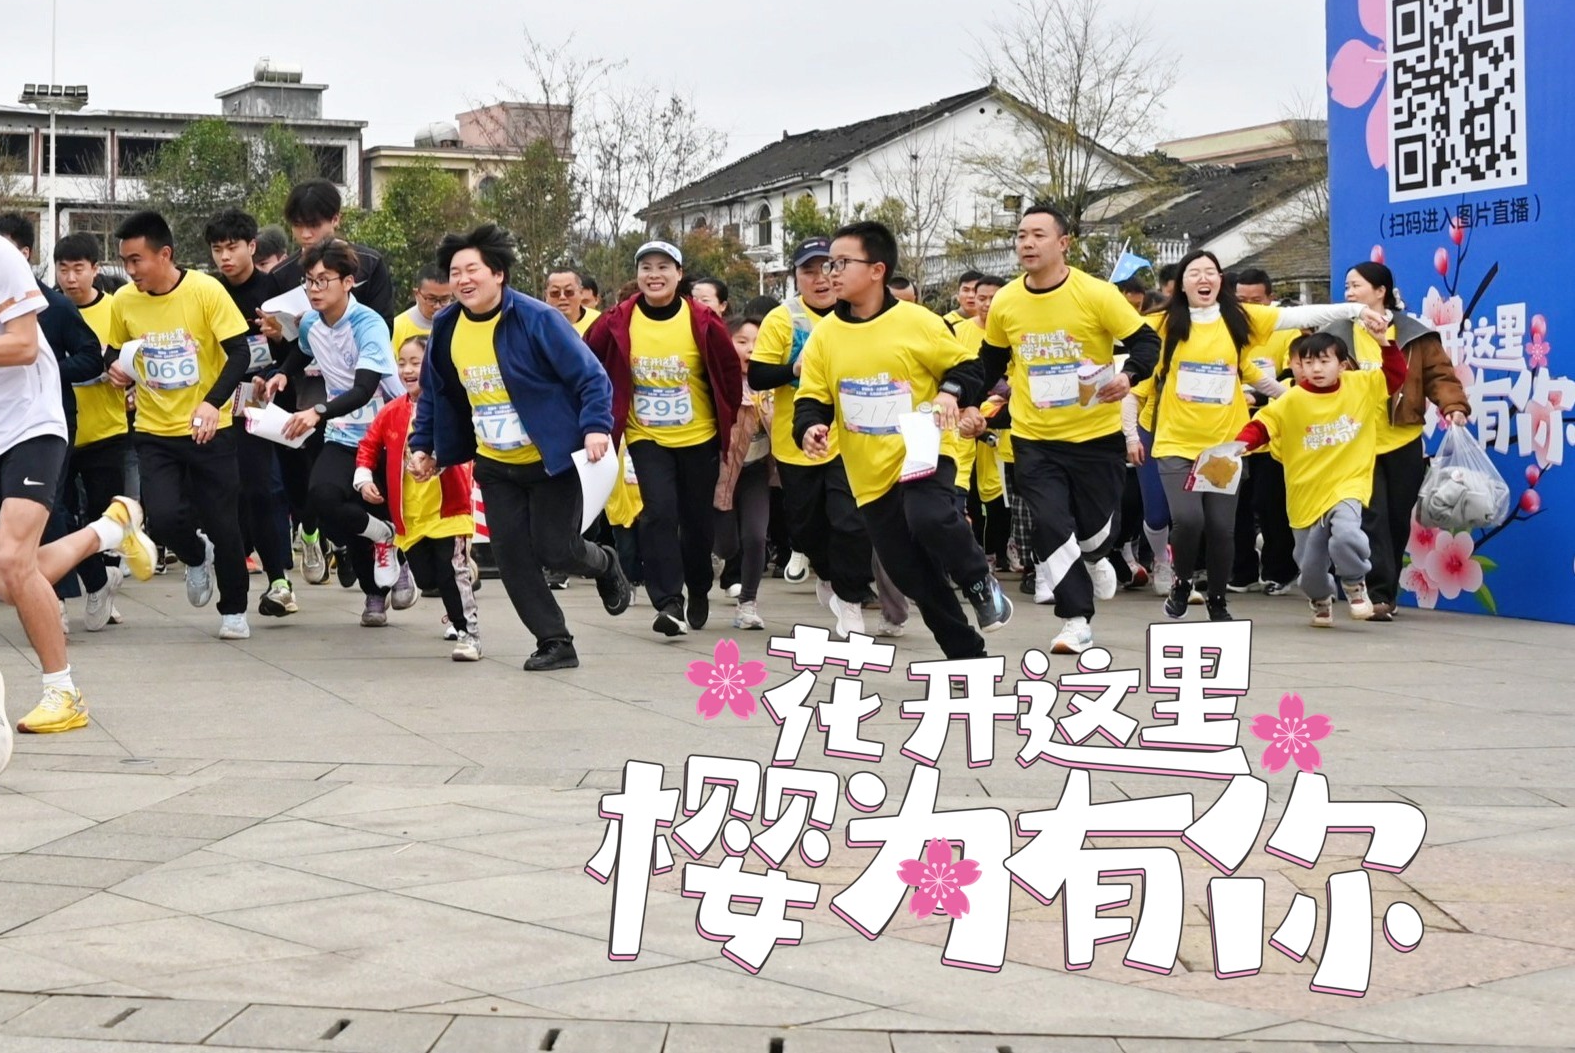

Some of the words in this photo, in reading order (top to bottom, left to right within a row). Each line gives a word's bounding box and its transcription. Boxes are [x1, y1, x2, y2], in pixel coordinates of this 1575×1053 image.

[146, 358, 195, 379] 066
[636, 397, 689, 417] 295
[851, 400, 897, 425] 217
